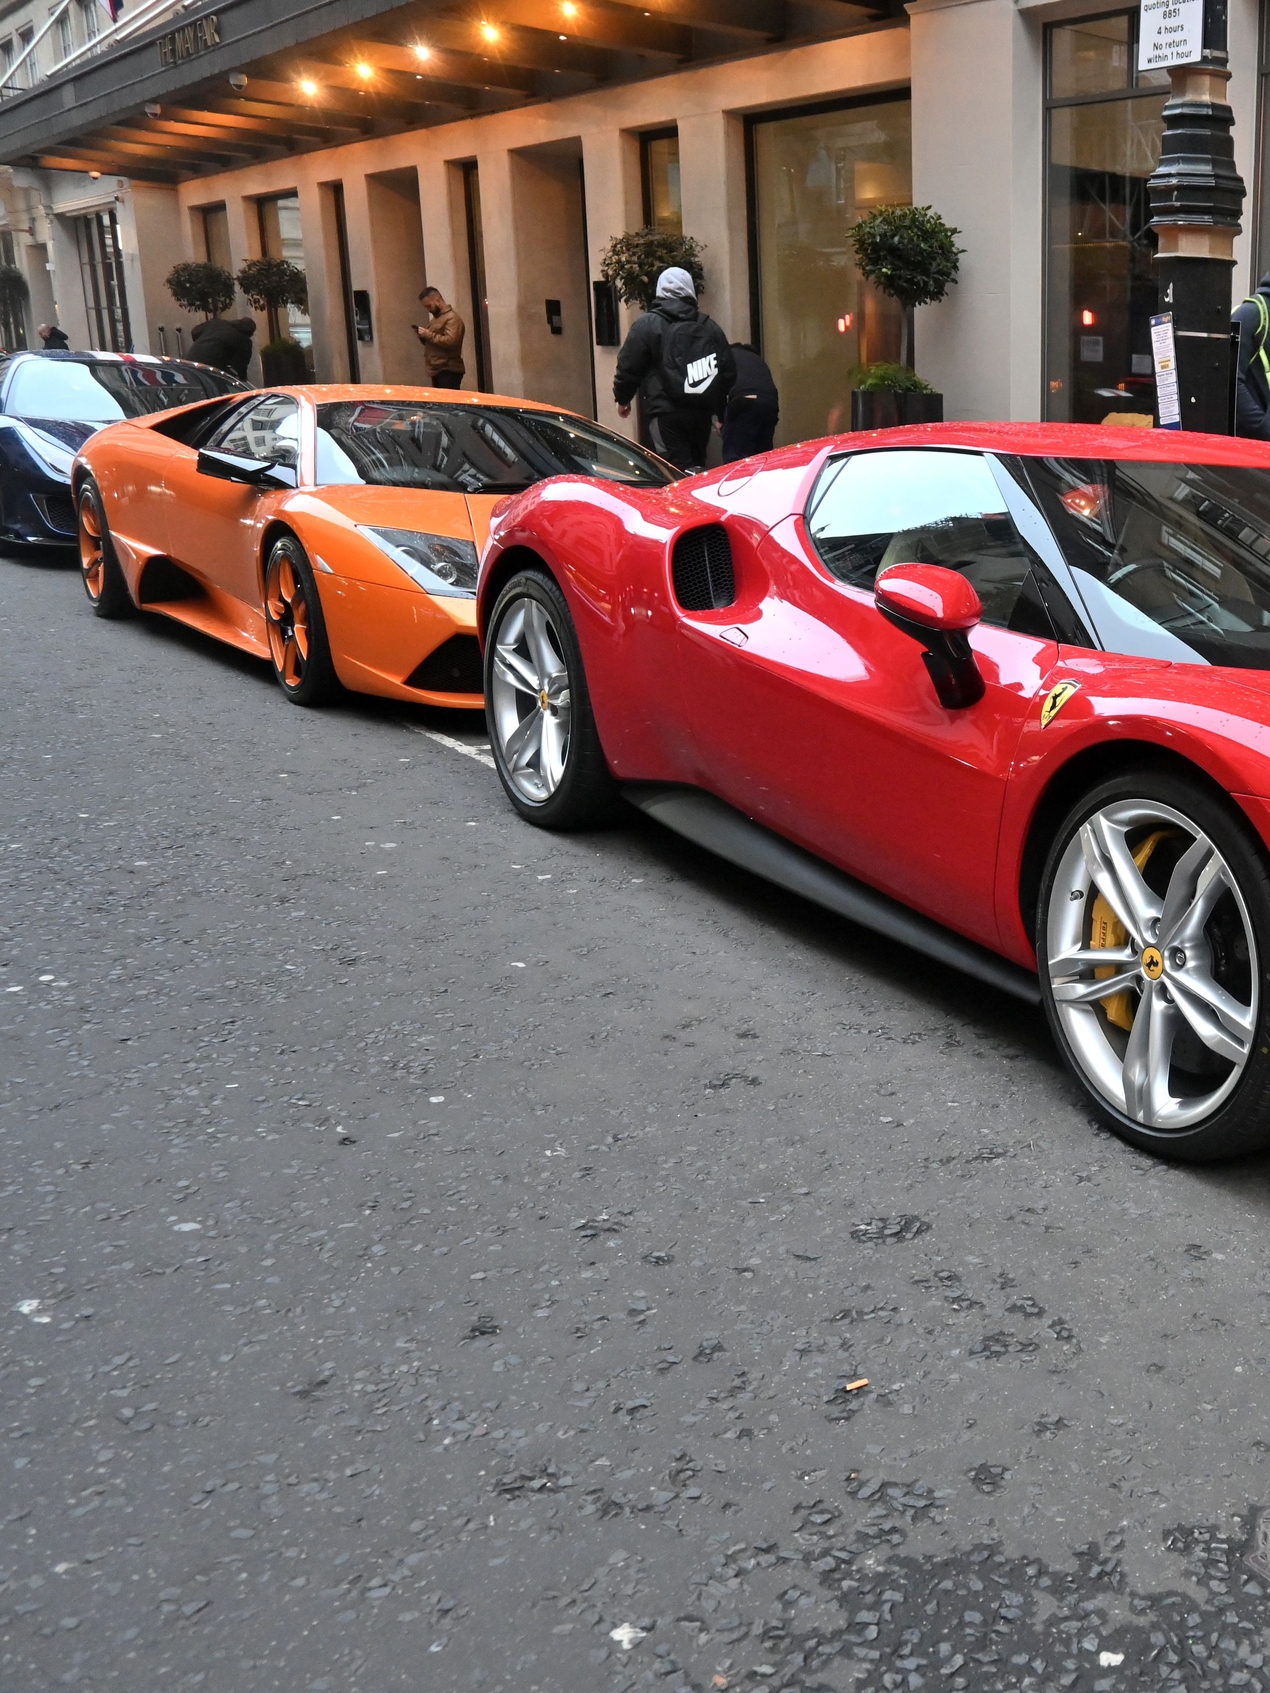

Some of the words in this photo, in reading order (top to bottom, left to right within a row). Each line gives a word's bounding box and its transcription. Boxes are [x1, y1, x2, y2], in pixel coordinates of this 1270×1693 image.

[1143, 0, 1170, 12] quoting
[1162, 8, 1180, 19] 8851
[1157, 26, 1162, 35] 4
[1164, 24, 1184, 34] hours
[156, 34, 174, 66] THE
[175, 24, 195, 60] MAY
[197, 15, 220, 50] FAIR
[1153, 42, 1163, 51] No
[1165, 39, 1188, 49] return
[1147, 53, 1169, 64] within
[1171, 51, 1174, 60] 1
[1176, 50, 1192, 59] hour
[686, 352, 718, 384] NIKE
